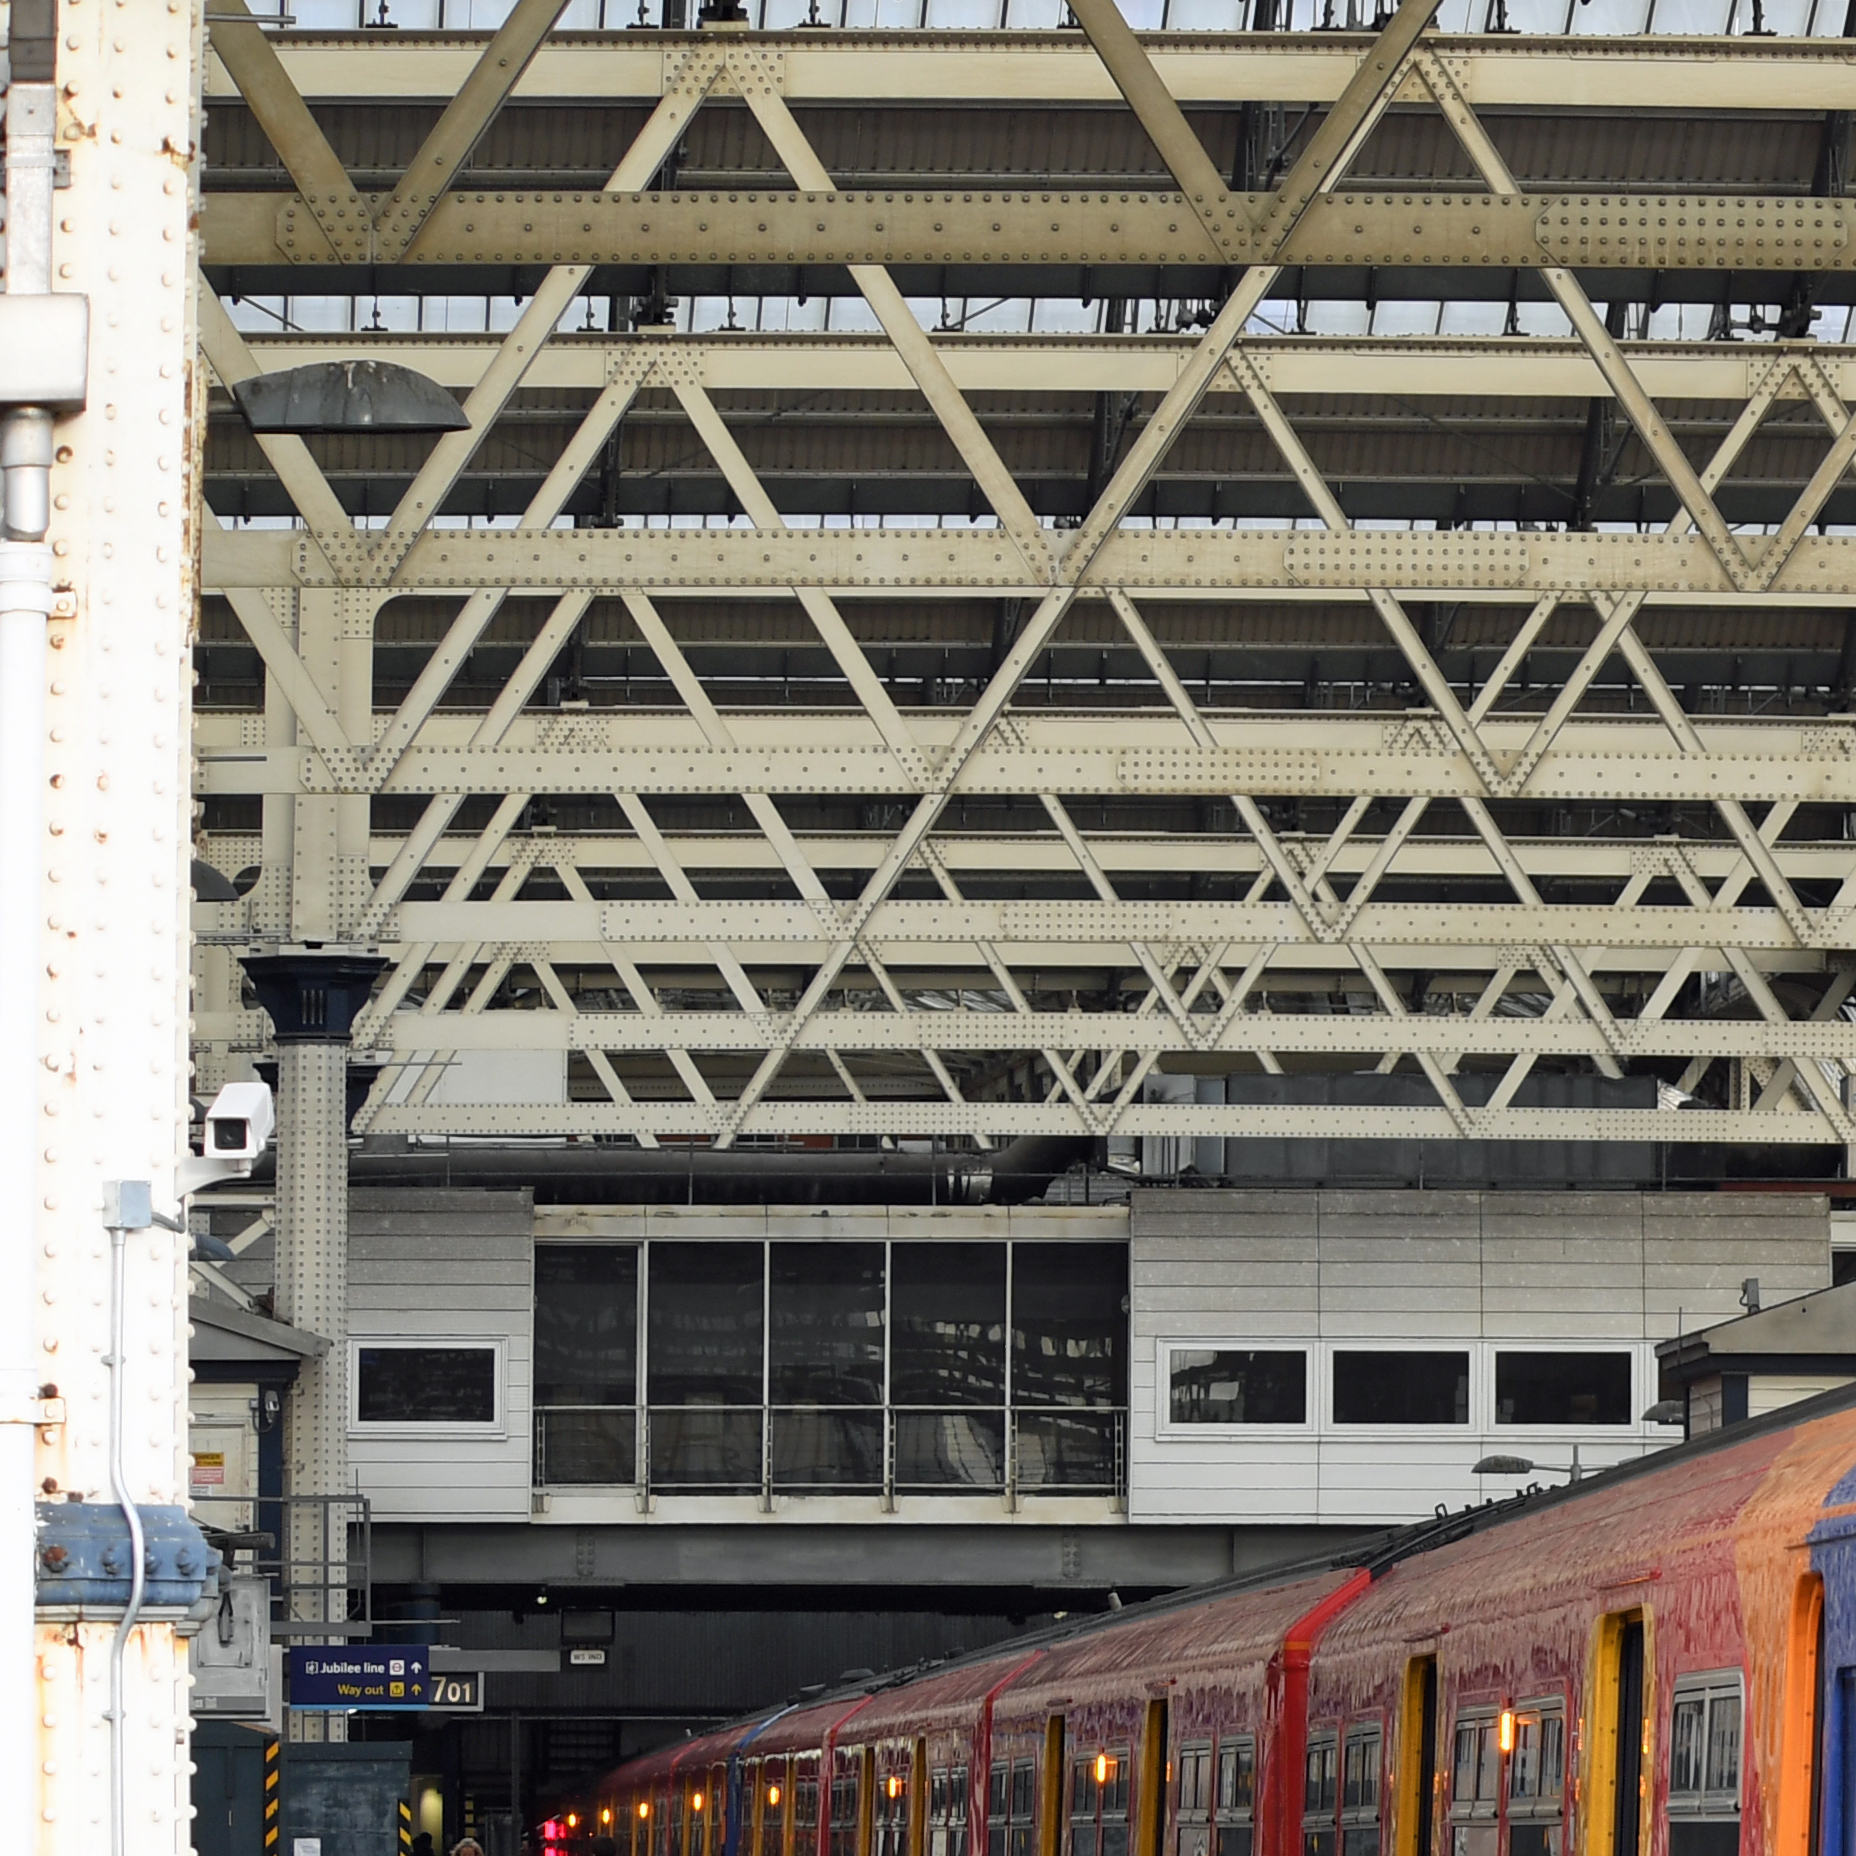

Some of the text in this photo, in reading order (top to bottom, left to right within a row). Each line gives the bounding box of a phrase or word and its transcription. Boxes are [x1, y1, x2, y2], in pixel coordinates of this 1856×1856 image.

[320, 1662, 385, 1674] Jubilee line
[338, 1684, 384, 1698] Way out
